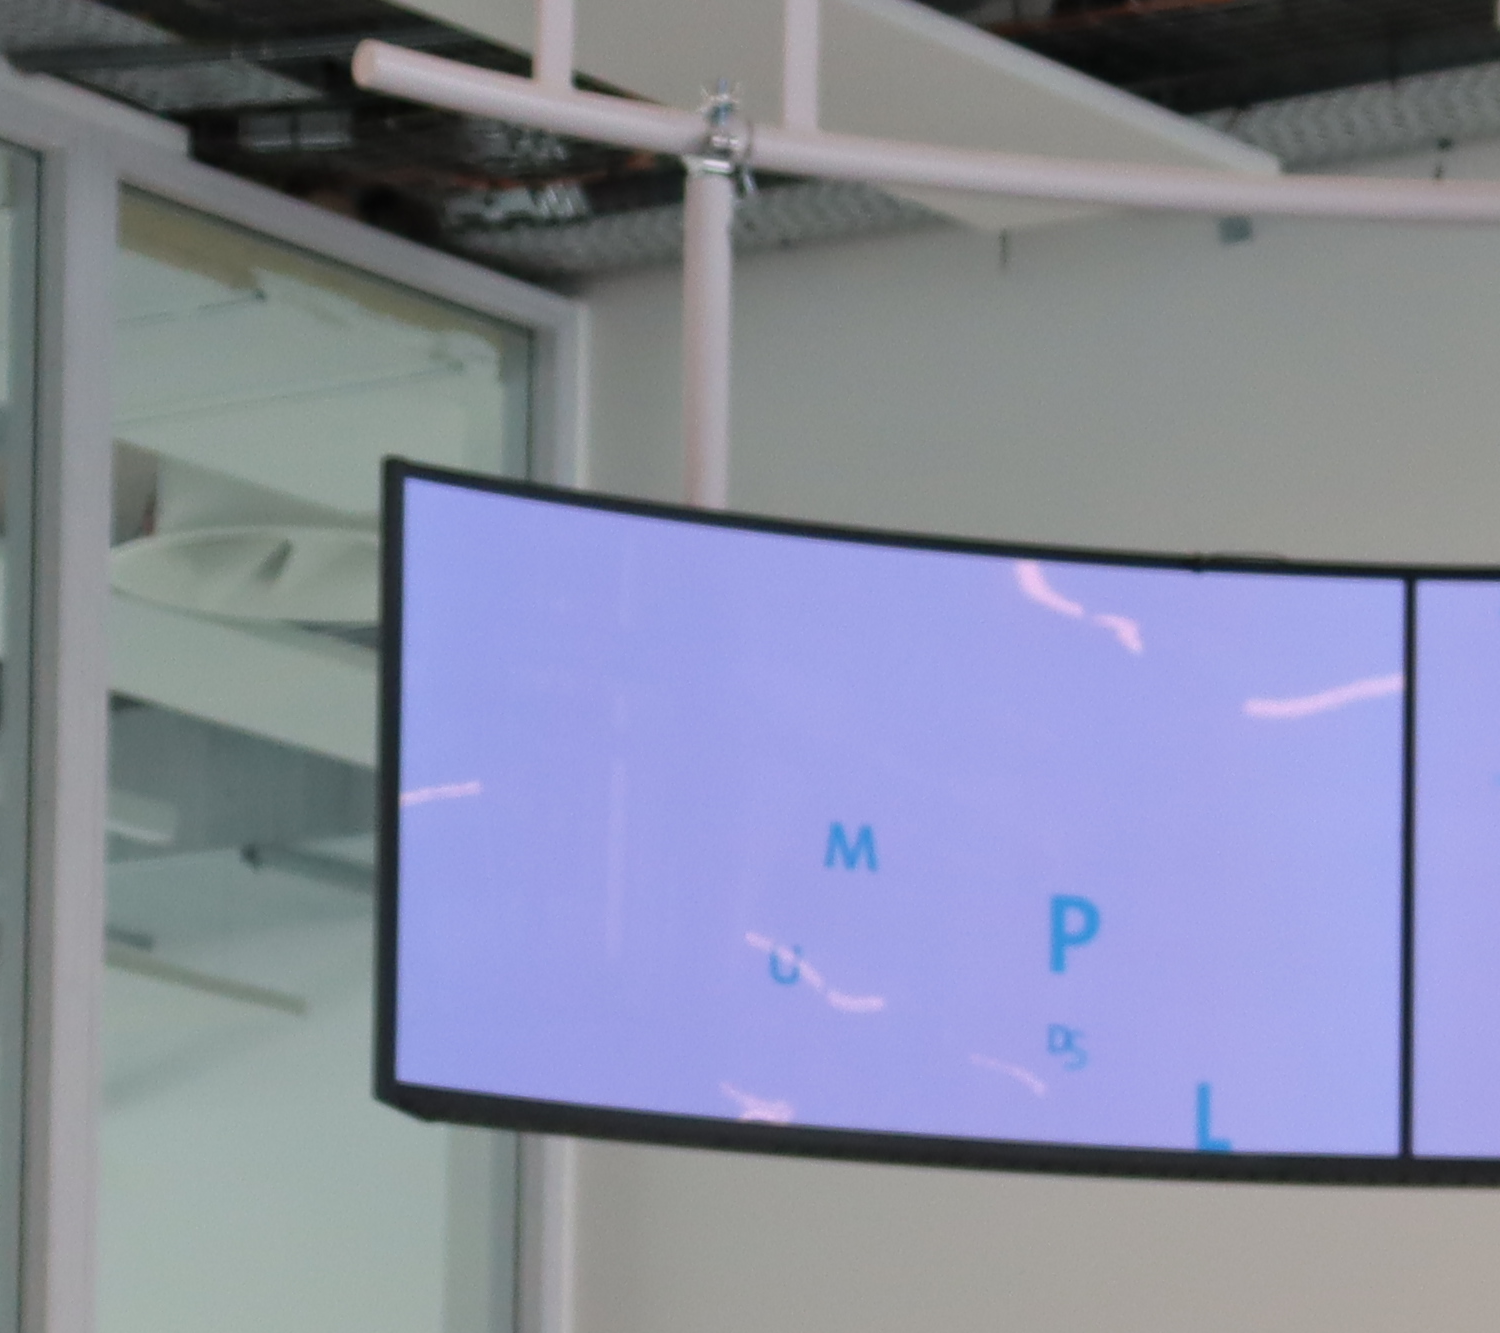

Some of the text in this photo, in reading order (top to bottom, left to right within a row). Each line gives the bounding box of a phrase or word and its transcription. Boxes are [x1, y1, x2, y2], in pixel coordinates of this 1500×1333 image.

[823, 821, 880, 873] M
[1048, 892, 1102, 975] P
[1194, 1081, 1233, 1153] L
